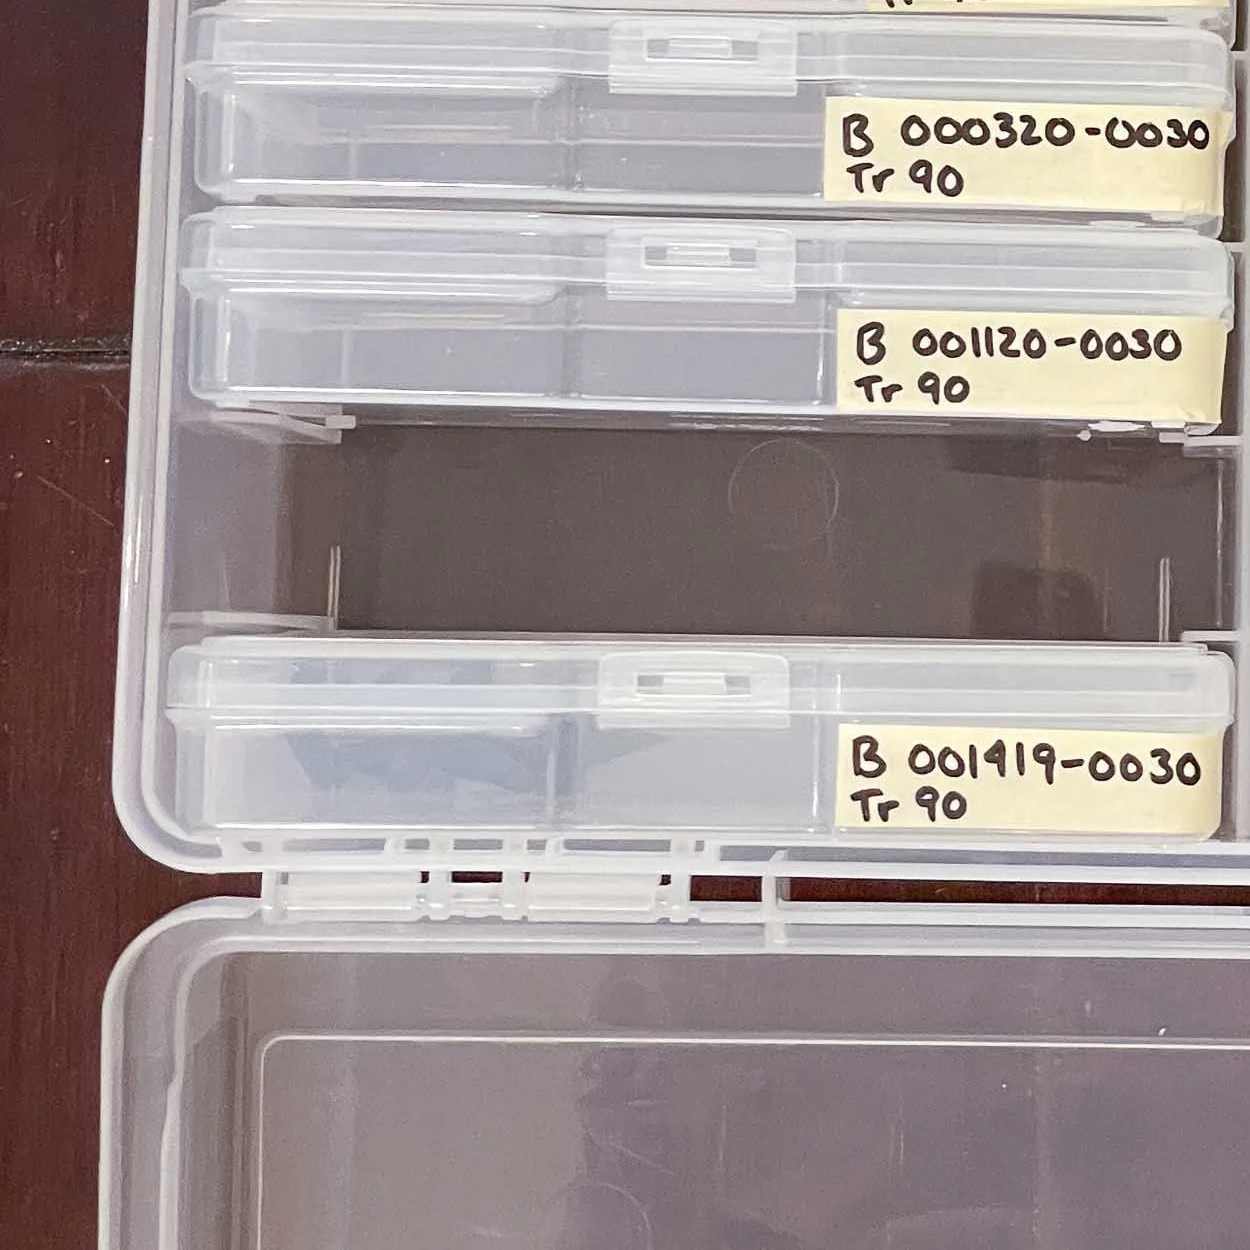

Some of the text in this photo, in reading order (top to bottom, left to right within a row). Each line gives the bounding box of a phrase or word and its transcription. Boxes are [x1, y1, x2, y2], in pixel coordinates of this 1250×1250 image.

[841, 111, 1211, 159] B 000320-0030
[845, 158, 965, 199] Tr 90
[855, 320, 1183, 367] B 001120-0030
[853, 370, 971, 406] Tr 90
[851, 734, 1202, 787] B 001419-0030
[849, 784, 968, 824] Tr 90
